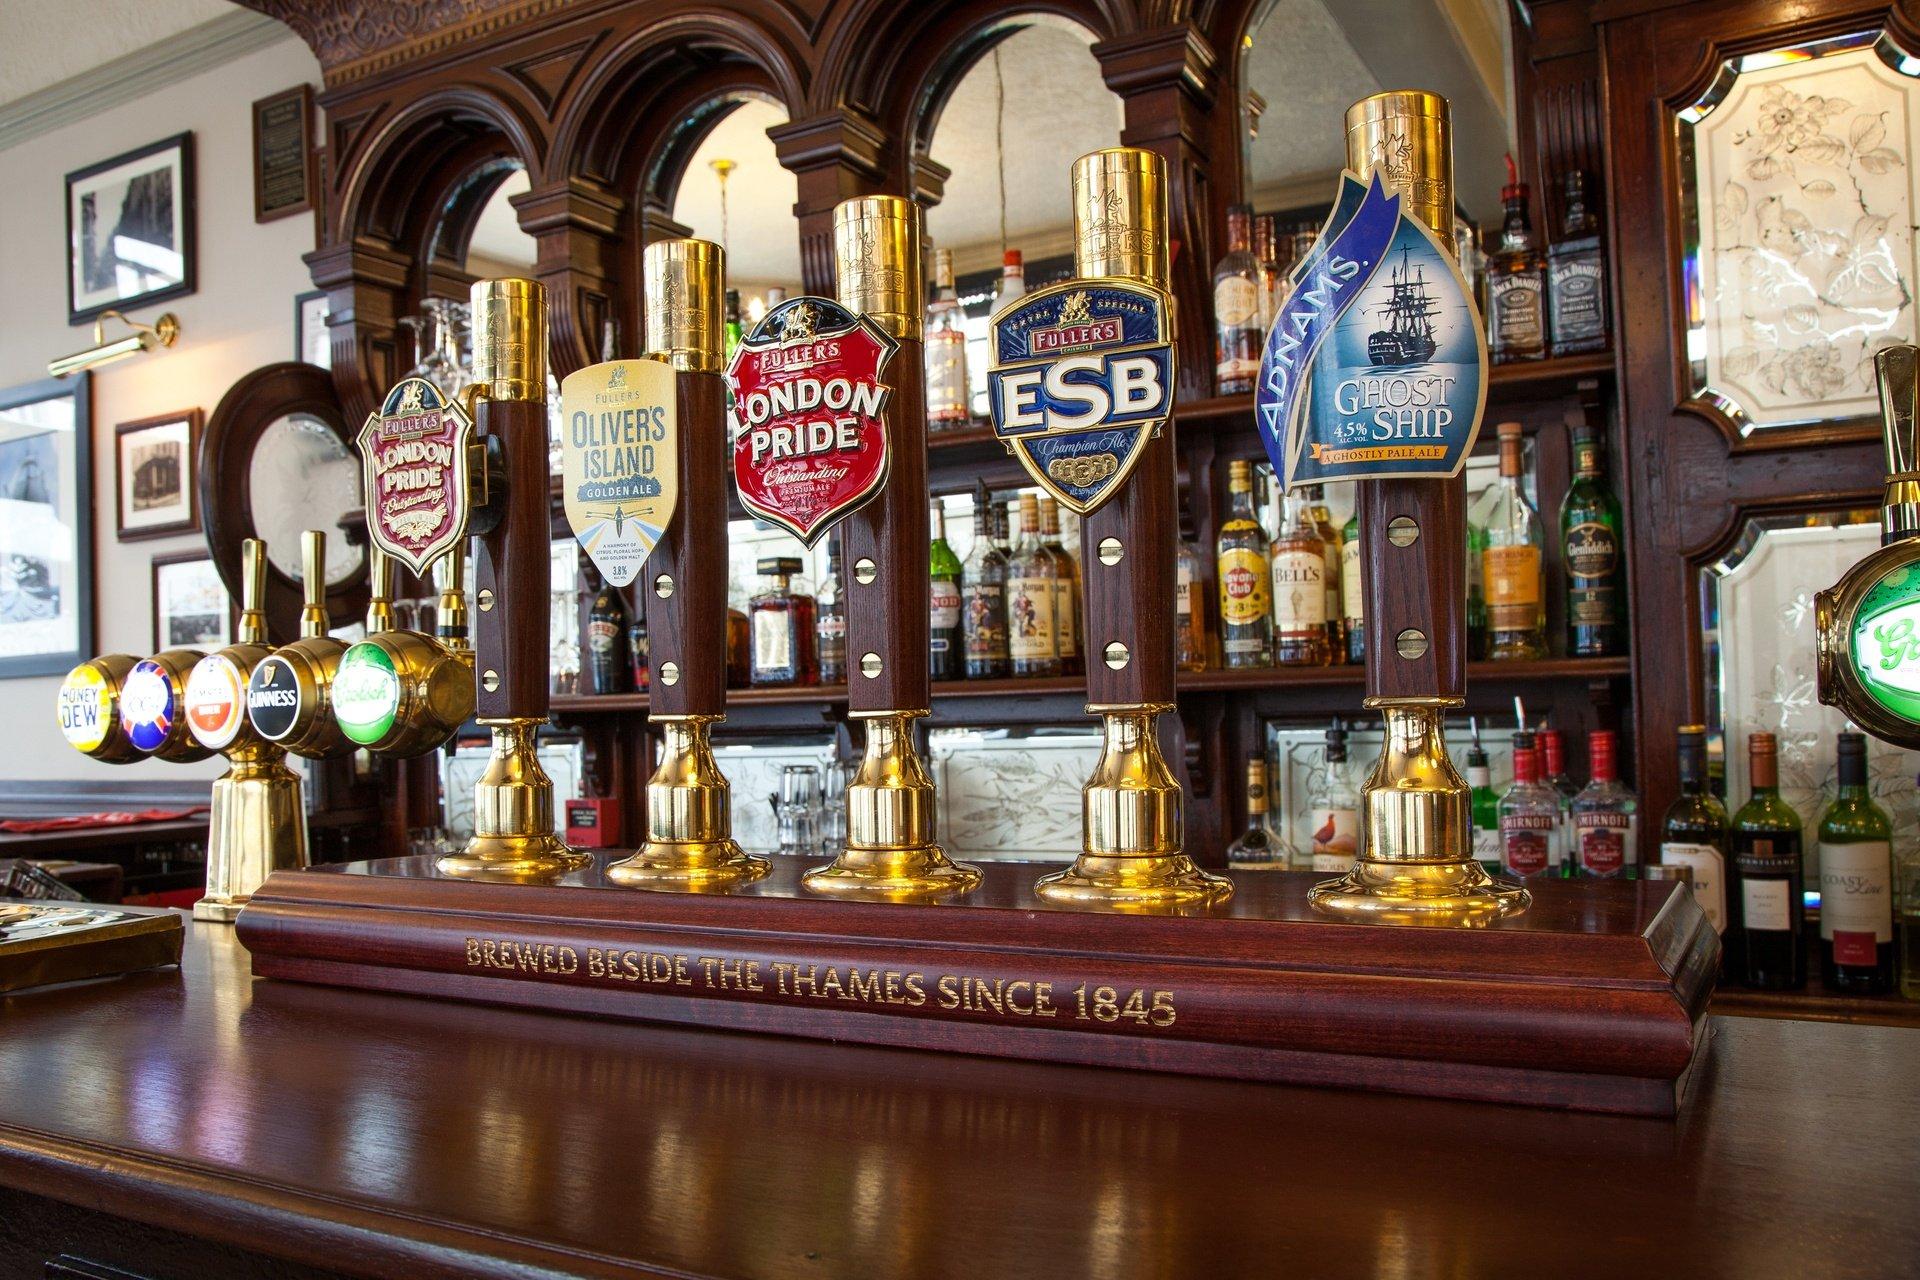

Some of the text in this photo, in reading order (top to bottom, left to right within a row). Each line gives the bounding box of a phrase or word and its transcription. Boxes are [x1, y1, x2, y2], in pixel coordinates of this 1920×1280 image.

[1097, 299, 1147, 313] SPECIAL
[1038, 324, 1114, 347] FULLER'S
[760, 341, 840, 369] FULLER'S
[595, 391, 640, 403] FULLER'S
[1001, 356, 1163, 430] ESB
[1334, 376, 1456, 416] GHOST
[728, 378, 885, 439] LONDON
[385, 415, 438, 434] FULLER'S
[572, 406, 665, 448] OLIVER'S
[1334, 422, 1368, 438] 4.5%
[1372, 408, 1453, 441] SHIP
[751, 417, 859, 461] PRIDE
[1037, 431, 1127, 458] Champion Ale
[374, 441, 453, 476] LONDON
[584, 445, 654, 479] ISLAND
[1334, 449, 1384, 461] GHOSTLY
[1388, 448, 1416, 458] PALE
[1418, 447, 1441, 457] ALE
[384, 467, 442, 494] PRIDE
[764, 464, 850, 486] Outstanding
[383, 488, 445, 513] Outstanding
[587, 484, 652, 498] GOLDEN ALE
[1567, 541, 1613, 556] Glenfiddich
[613, 565, 627, 576] 3.8%
[1275, 566, 1320, 583] BELL'S
[1227, 584, 1251, 595] Club
[63, 688, 98, 703] HONEY
[249, 689, 296, 708] GUINNESS
[62, 704, 98, 729] DEW
[1823, 874, 1863, 886] COAST
[465, 937, 1177, 1026] BREWED BESIDE THE THAMES SINCE 1845
